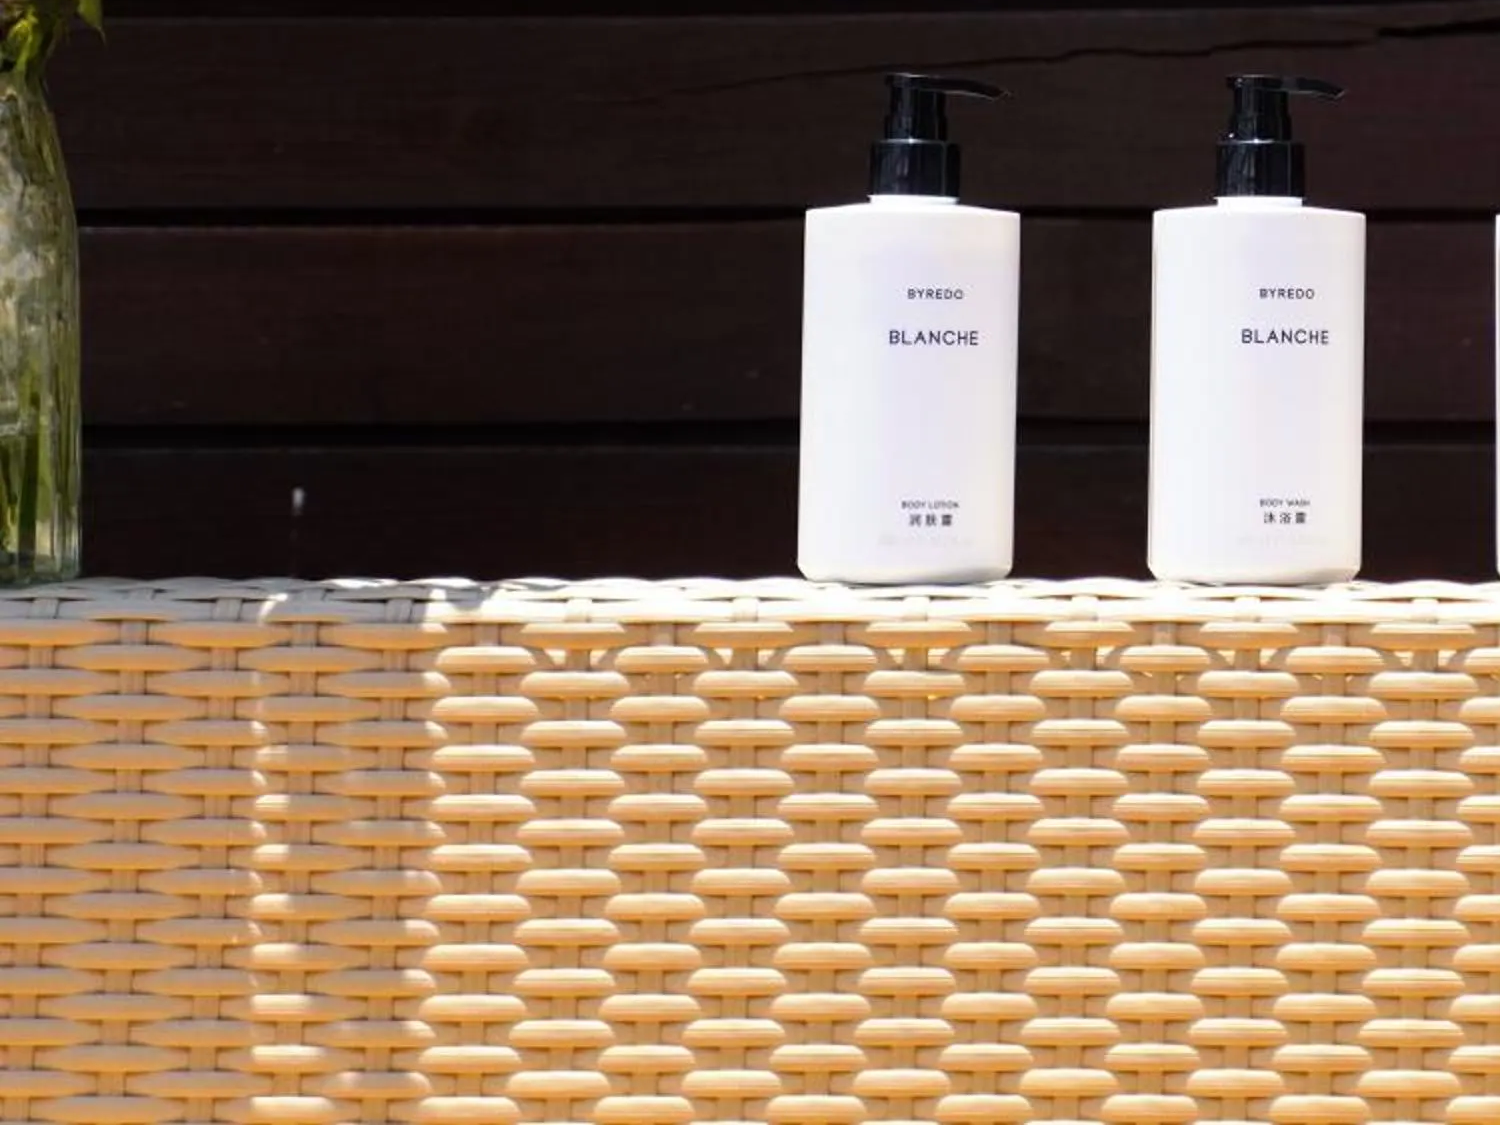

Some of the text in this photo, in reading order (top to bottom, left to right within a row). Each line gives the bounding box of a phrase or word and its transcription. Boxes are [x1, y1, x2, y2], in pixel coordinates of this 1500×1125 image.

[906, 287, 964, 300] BYREDO
[1259, 287, 1315, 300] BYREDO
[889, 329, 979, 346] BLANCHE
[1241, 328, 1329, 345] BLANCHE
